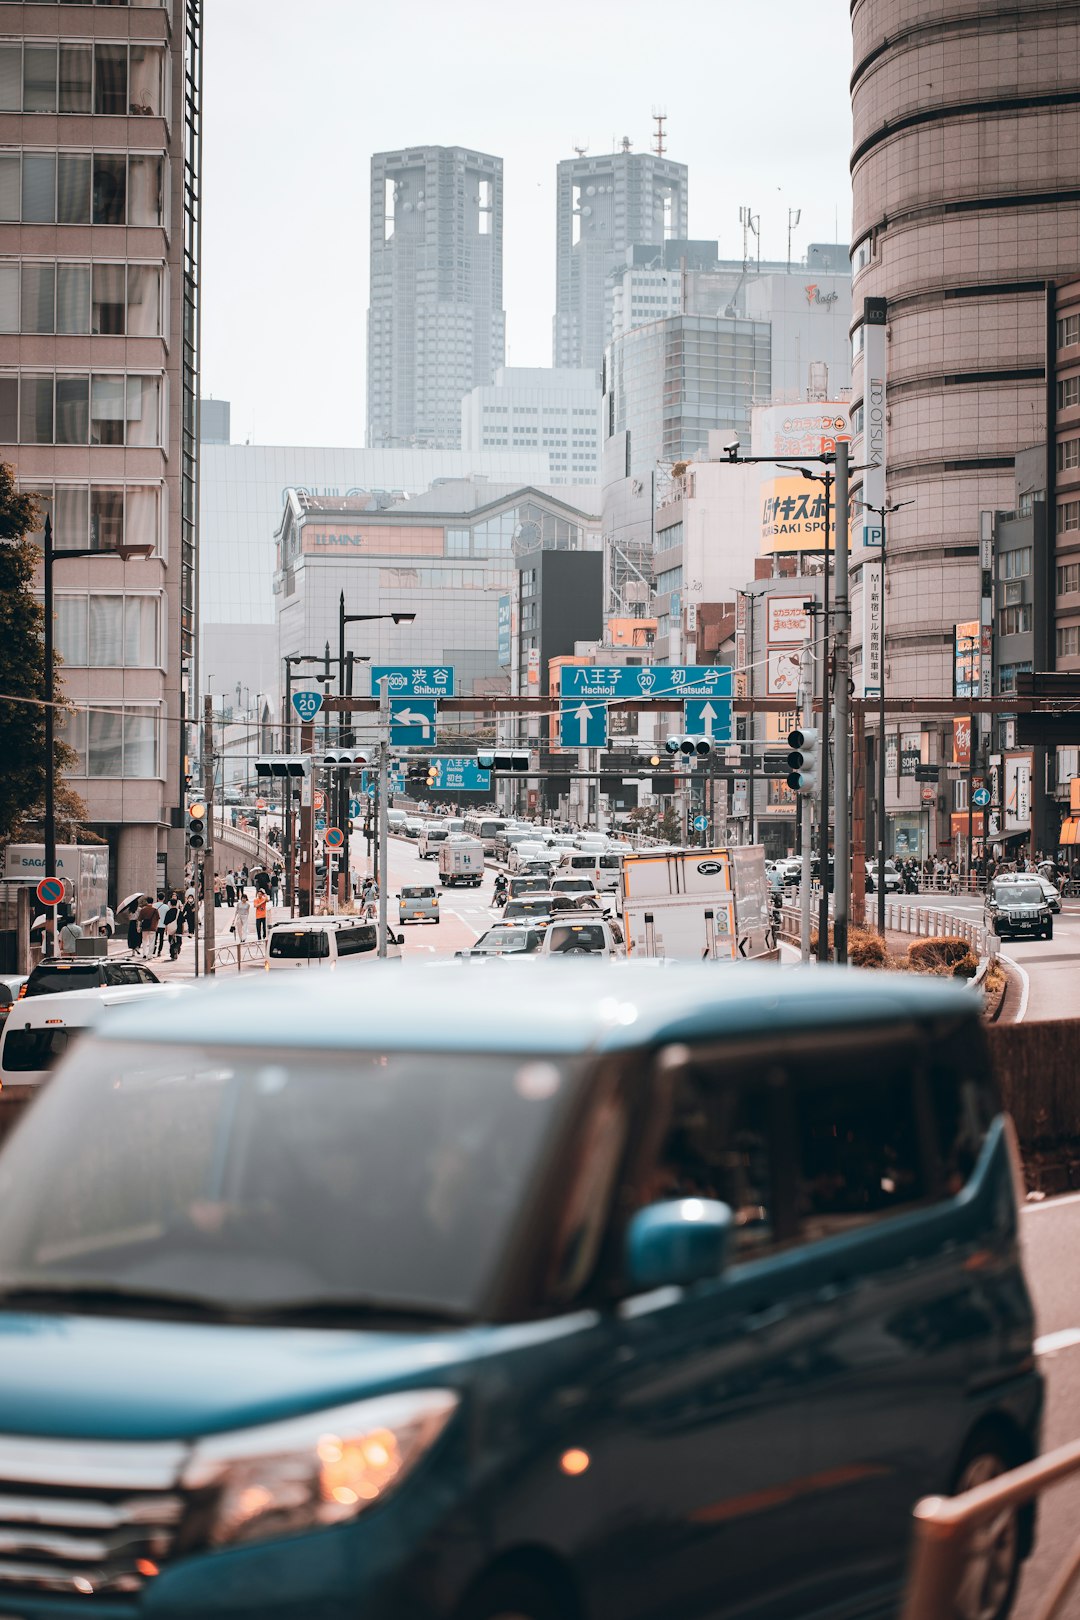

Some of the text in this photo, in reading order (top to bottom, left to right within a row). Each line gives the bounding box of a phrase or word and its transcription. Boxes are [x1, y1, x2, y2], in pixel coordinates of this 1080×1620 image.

[805, 284, 838, 312] Flags
[792, 416, 834, 430] カラオケ
[871, 530, 881, 542] P
[390, 678, 403, 686] 305
[412, 669, 449, 685] 渋谷
[574, 669, 622, 685] 八王子
[640, 675, 652, 685] 20
[671, 669, 719, 685] 初台
[413, 686, 447, 696] Shibuya
[581, 686, 615, 695] Hachioji
[676, 686, 713, 695] Hatsudai
[300, 700, 315, 711] 20
[447, 759, 471, 767] 八王子
[447, 774, 463, 782] 初台
[22, 858, 64, 867] SAGAA
